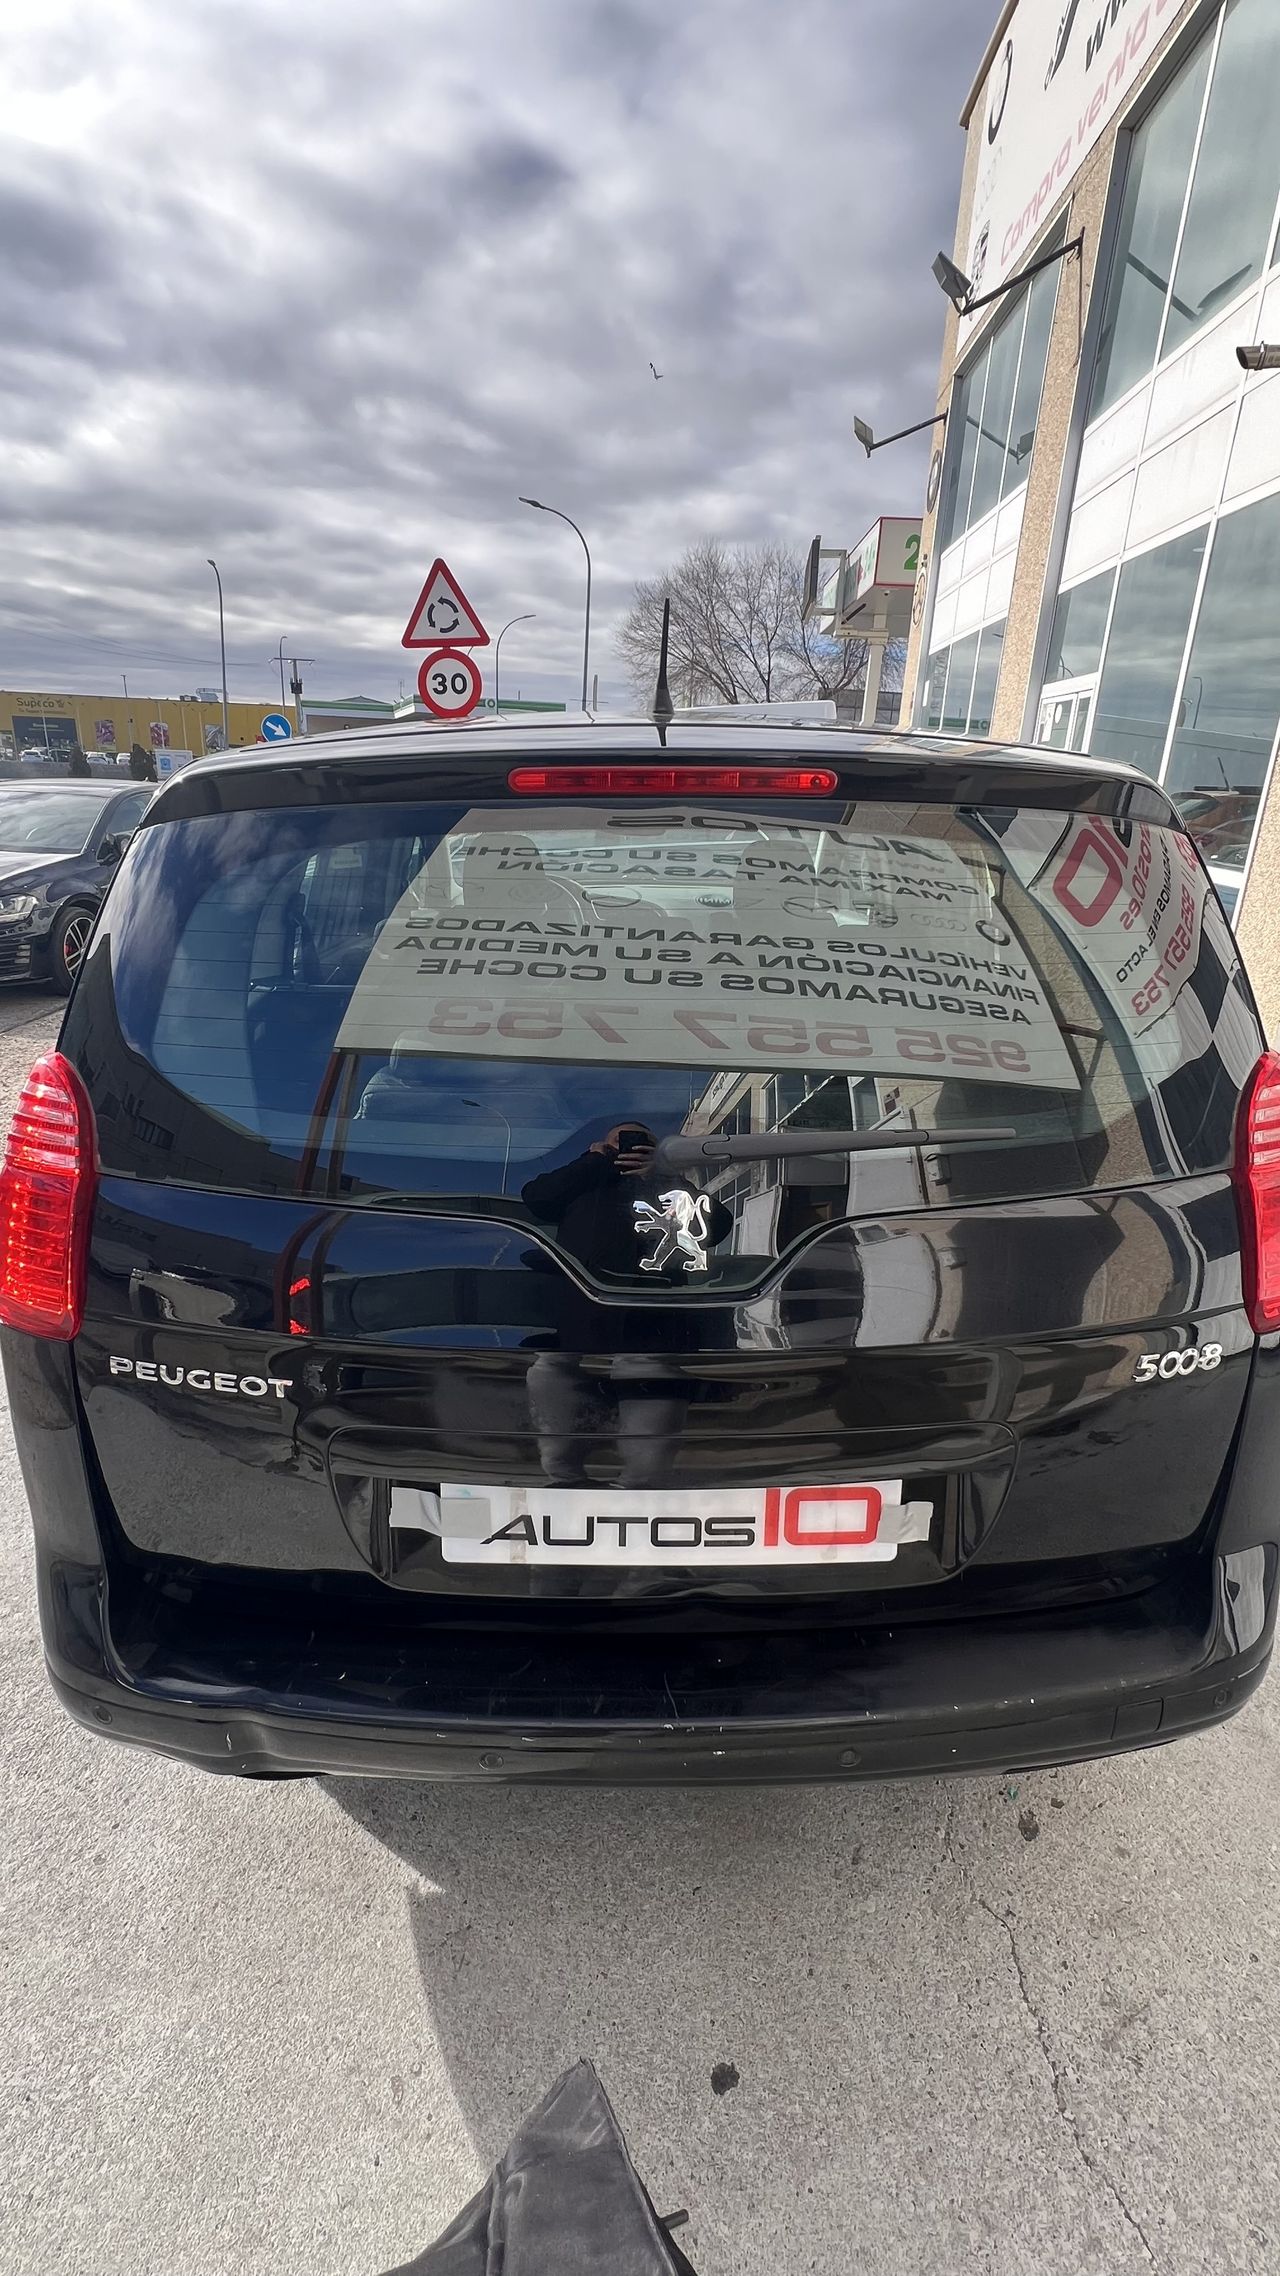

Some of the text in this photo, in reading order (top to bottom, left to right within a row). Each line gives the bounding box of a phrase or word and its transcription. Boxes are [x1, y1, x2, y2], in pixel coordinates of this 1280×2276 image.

[432, 672, 467, 695] 30
[109, 1355, 294, 1398] PEUGEOT
[1132, 1343, 1223, 1382] 5008
